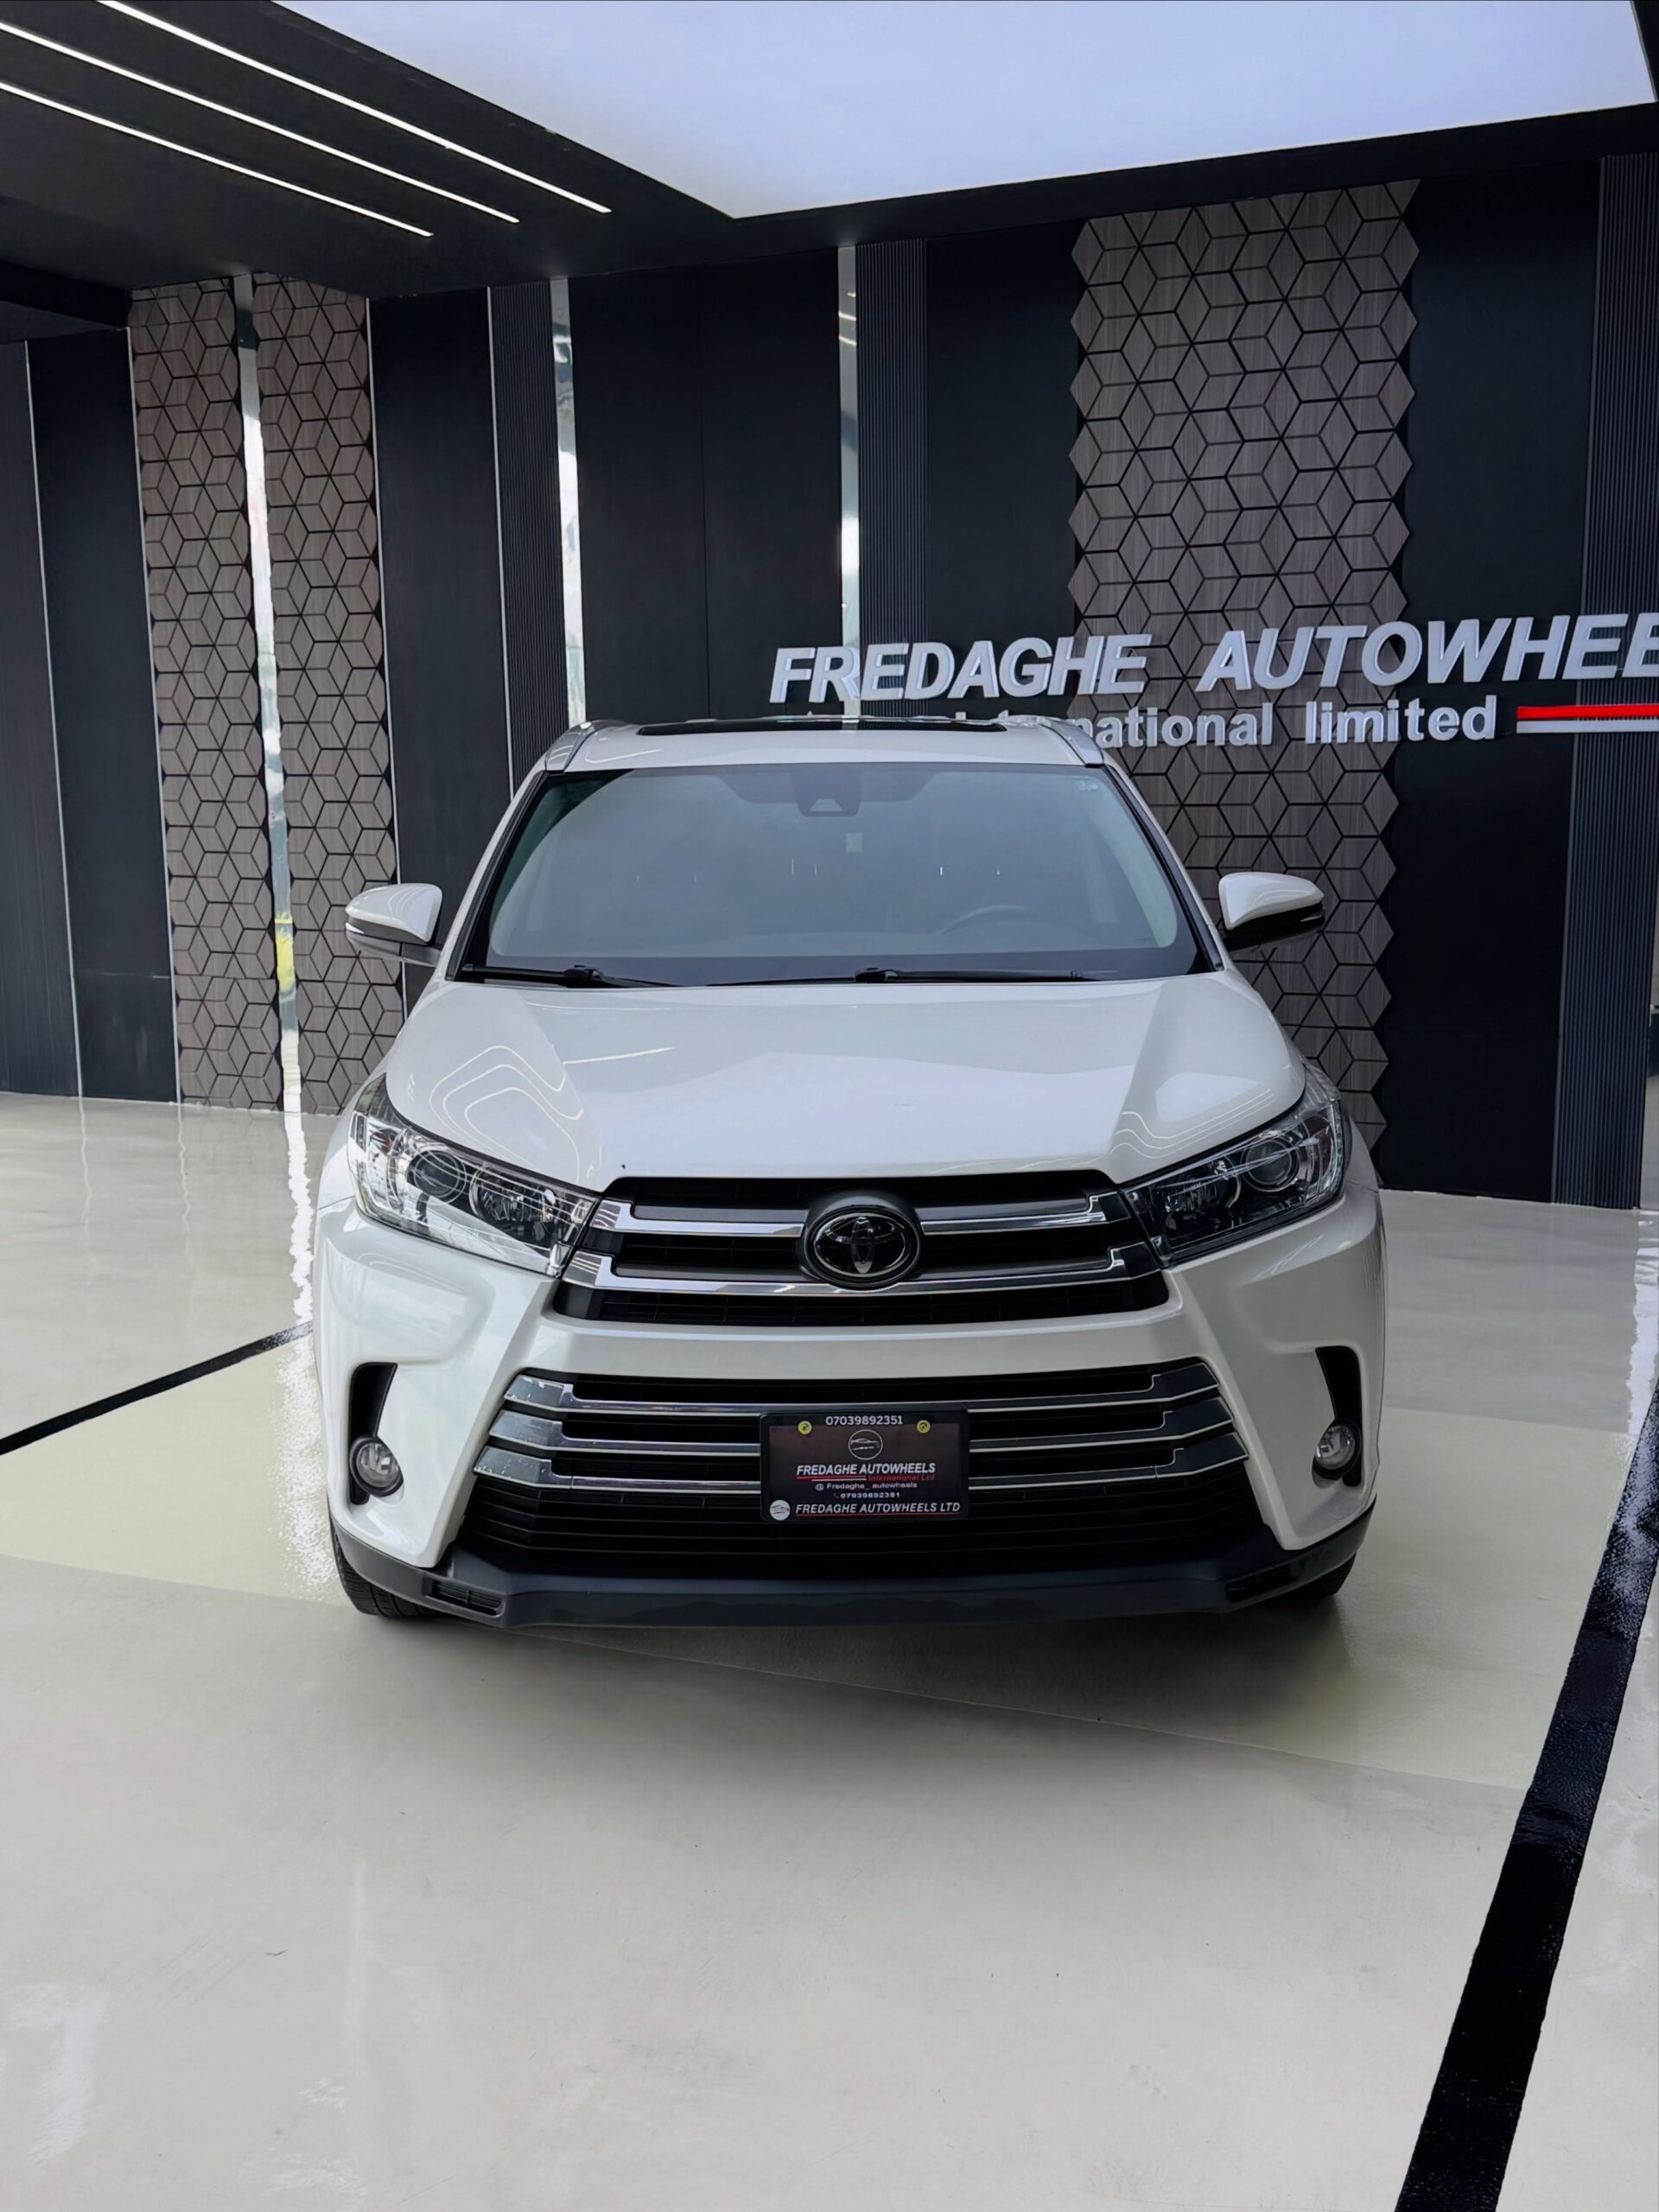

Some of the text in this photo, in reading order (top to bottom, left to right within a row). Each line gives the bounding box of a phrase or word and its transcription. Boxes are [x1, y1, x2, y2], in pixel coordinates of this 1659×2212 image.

[769, 633, 1153, 703] FREDAGHE
[1306, 694, 1497, 744] limited
[825, 1415, 903, 1426] 07039892351
[796, 1462, 936, 1476] FREDAGHE AUTOWHEELS
[795, 1502, 961, 1514] FREDAGHE AUTOWHEELS LTD
